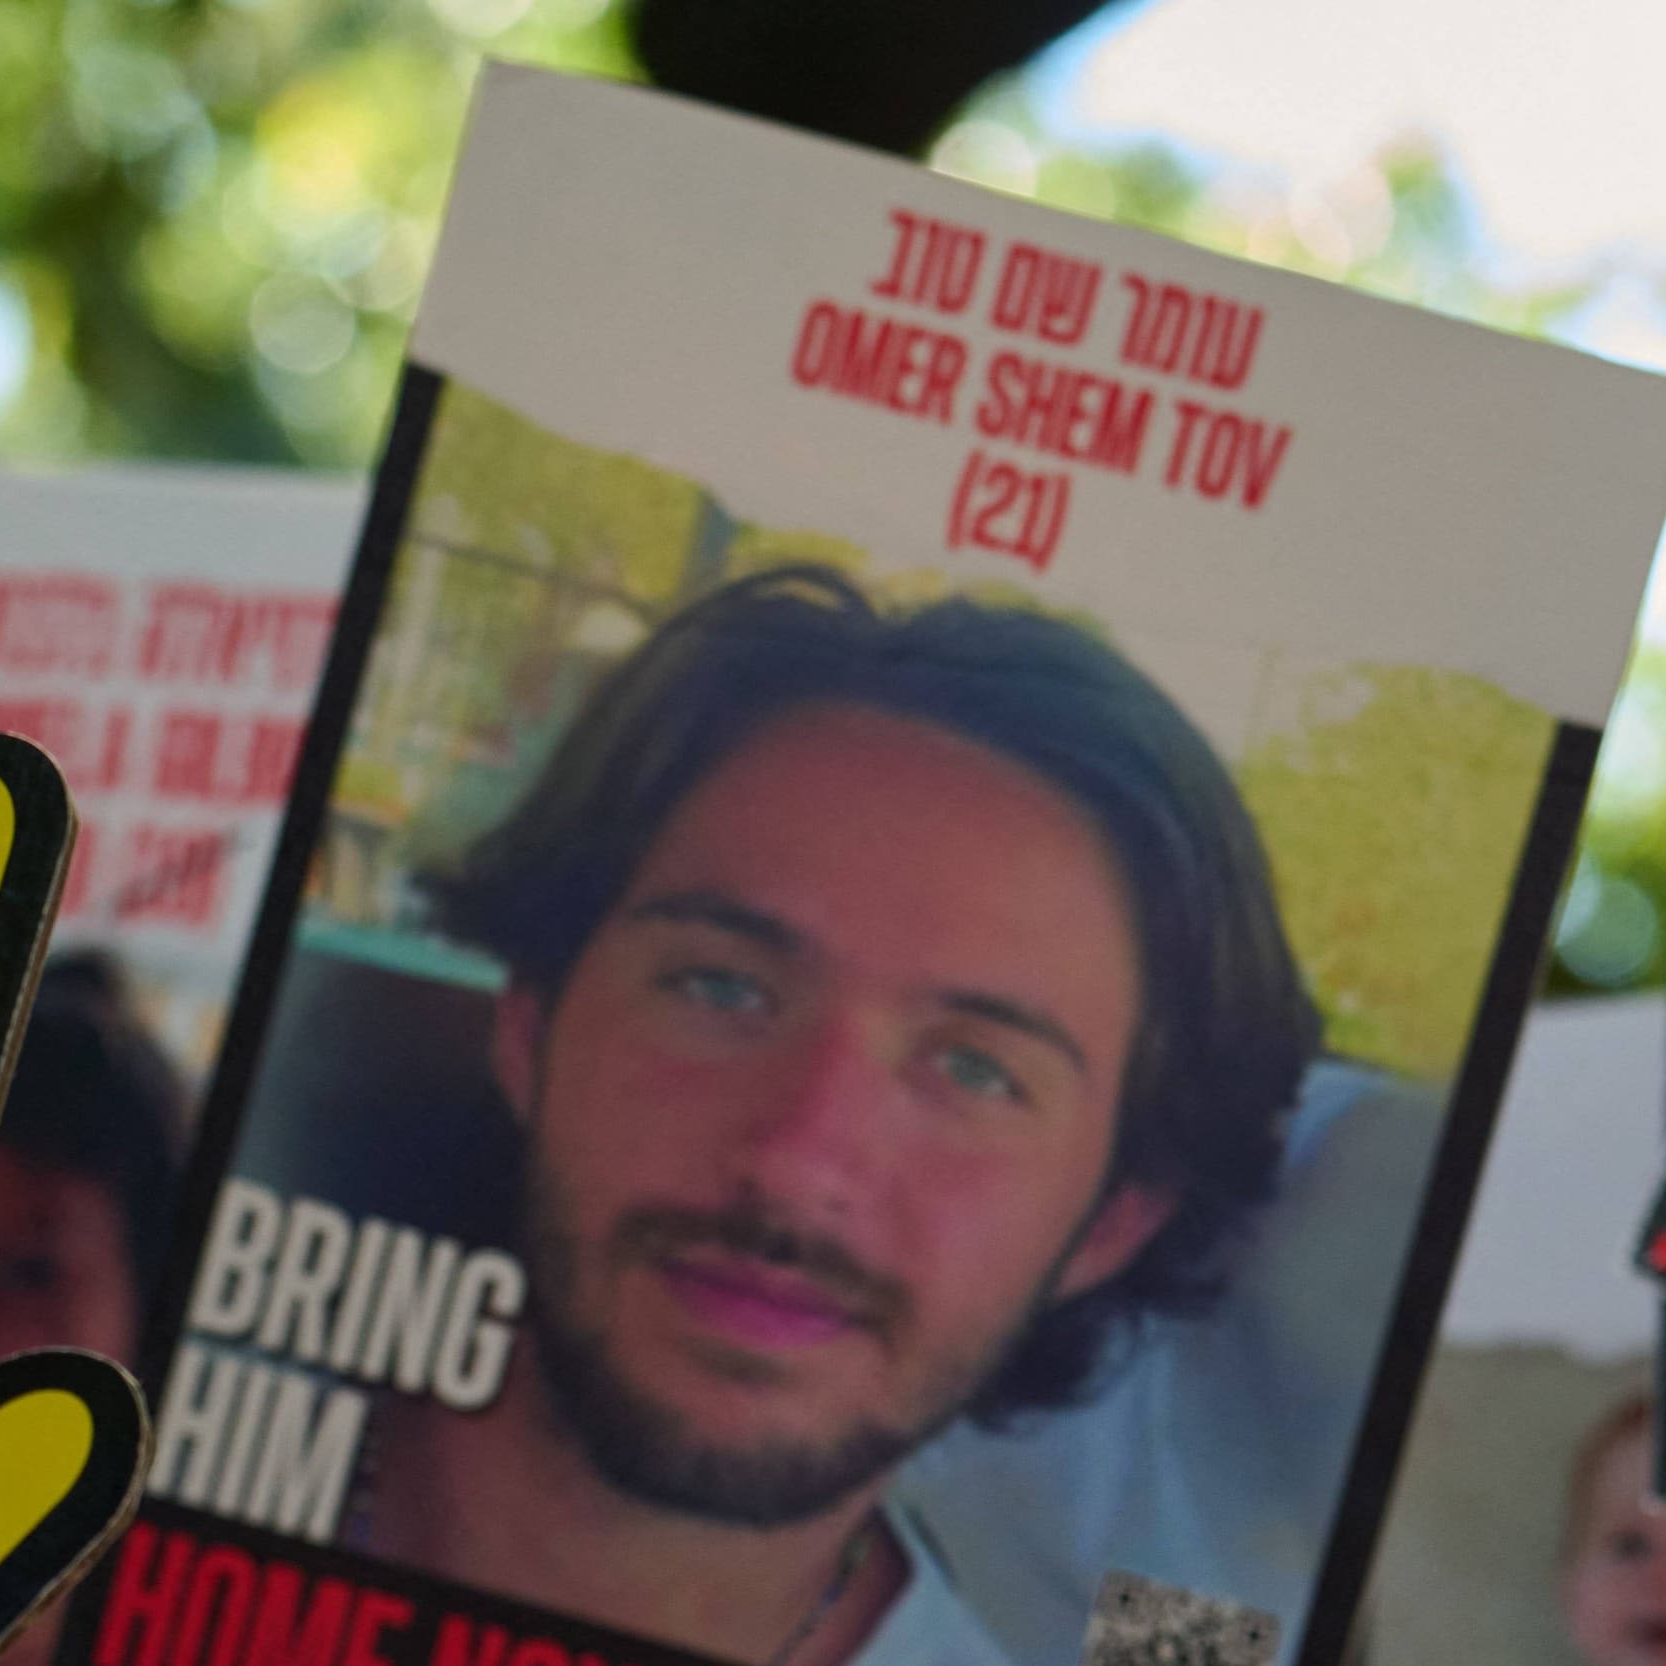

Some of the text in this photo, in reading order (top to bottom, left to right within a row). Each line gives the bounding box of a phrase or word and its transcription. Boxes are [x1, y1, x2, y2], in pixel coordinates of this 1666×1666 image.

[870, 208, 1265, 392] עומר שם טוב
[790, 297, 1293, 511] OMER SHEM TOV
[944, 448, 1072, 574] (21)
[189, 1176, 524, 1411] BRING
[147, 1347, 372, 1544] HIM
